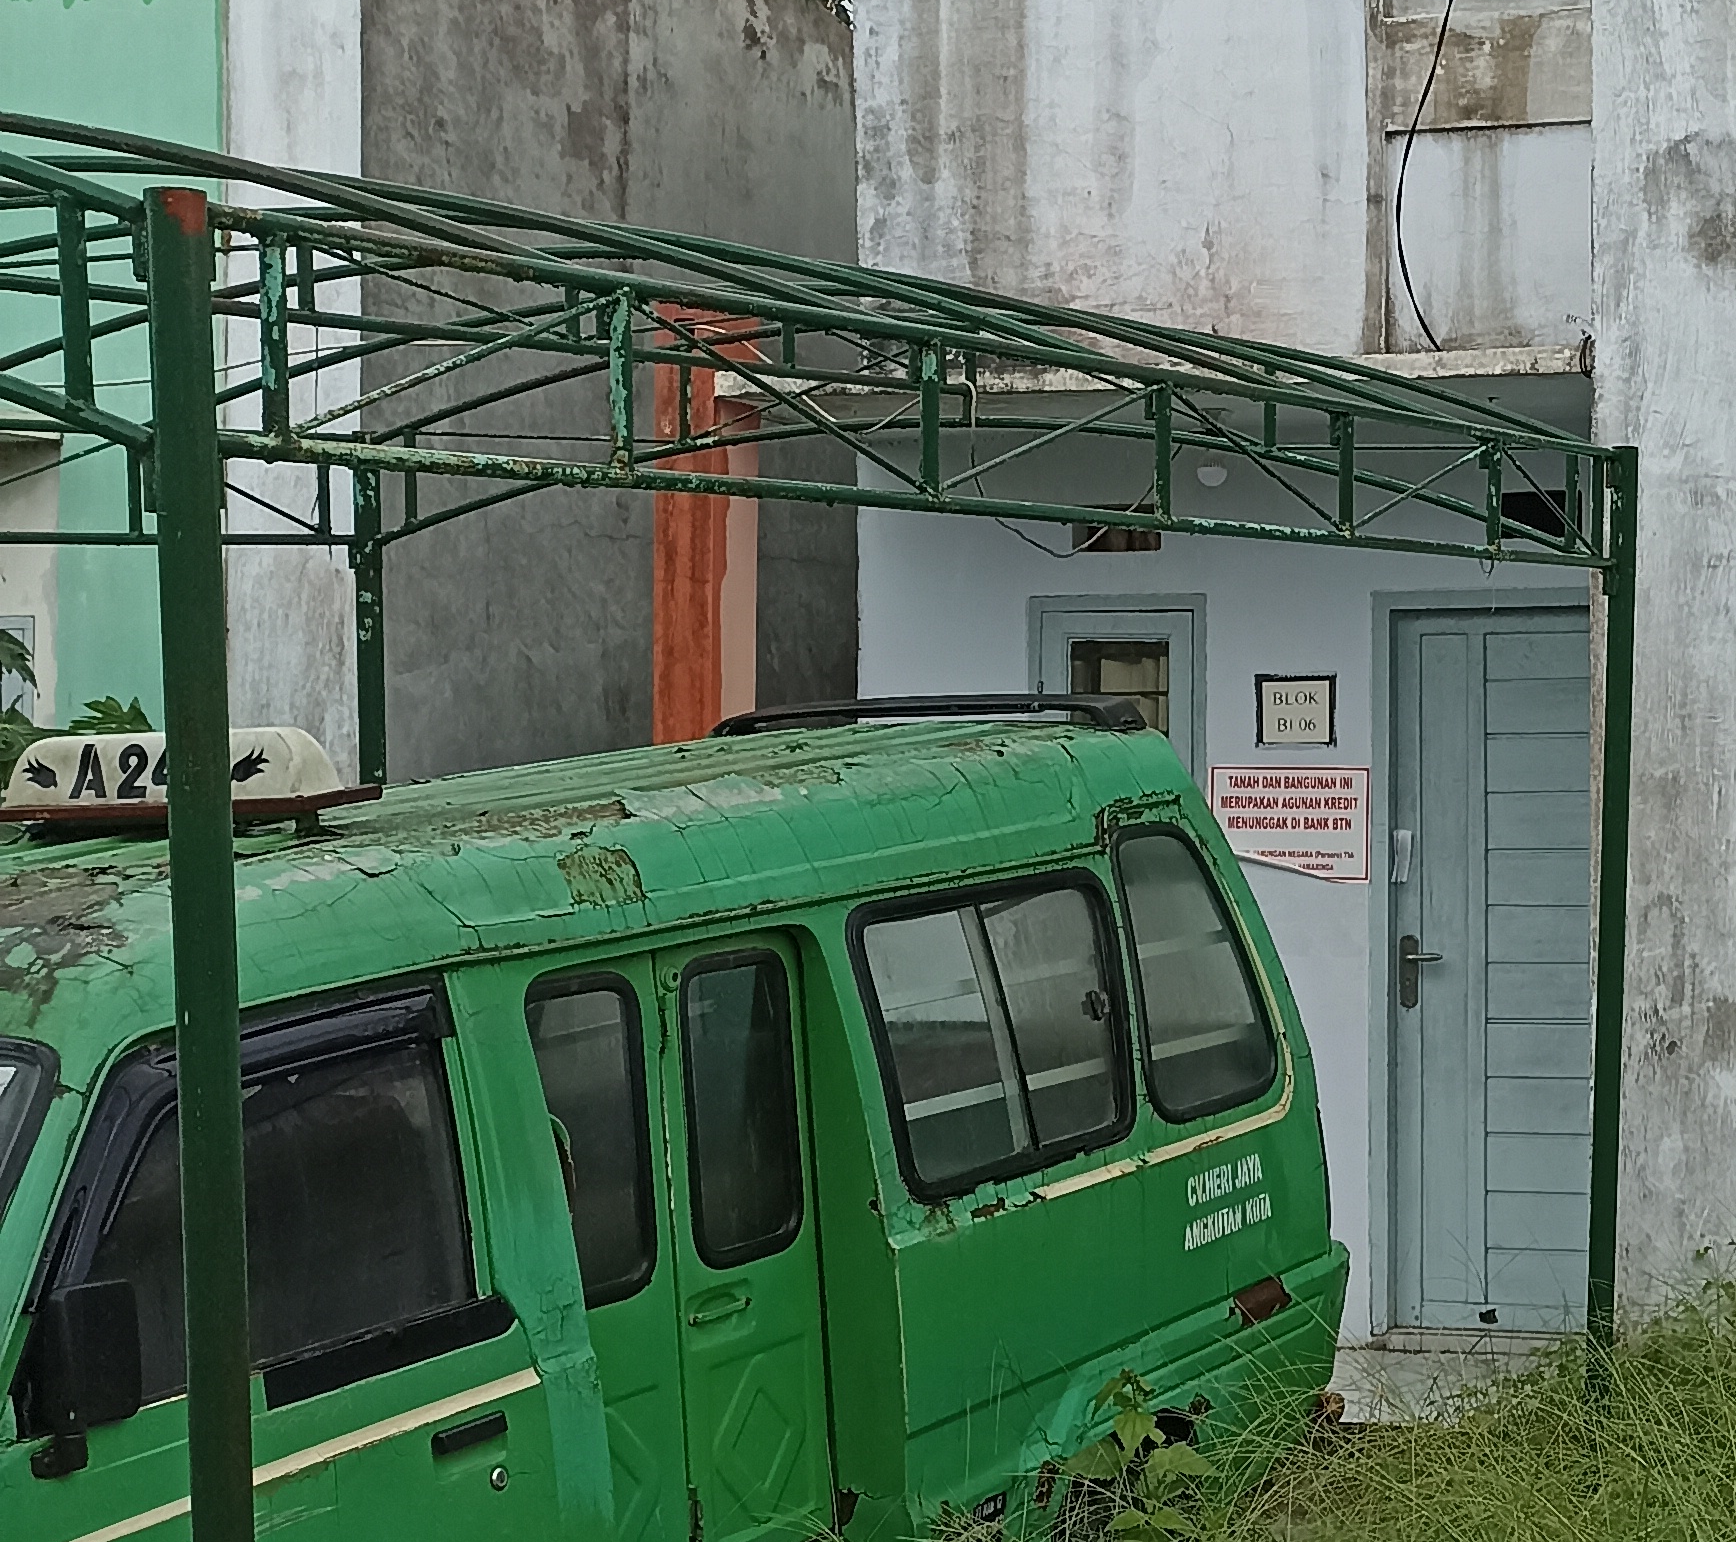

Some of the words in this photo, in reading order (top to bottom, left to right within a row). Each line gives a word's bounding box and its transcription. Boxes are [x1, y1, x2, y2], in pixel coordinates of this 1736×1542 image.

[1273, 691, 1319, 706] BLOK
[1299, 717, 1316, 731] 06
[1228, 776, 1259, 789] TANAH
[1262, 776, 1281, 789] DAN
[1284, 776, 1336, 790] BANGUNAN
[1339, 777, 1352, 789] INI
[1221, 796, 1279, 810] MERUPAKAN
[1281, 796, 1321, 809] AGUNAN
[1324, 797, 1358, 810] KREDIT
[1227, 816, 1288, 830] MENUNGGAK
[1291, 817, 1300, 829] DI
[1303, 817, 1329, 830] BANK
[1332, 817, 1352, 830] BTN
[1235, 1153, 1263, 1189] JAYA
[1184, 1205, 1242, 1251] ANGKUTAN
[1246, 1193, 1272, 1225] KOTA
